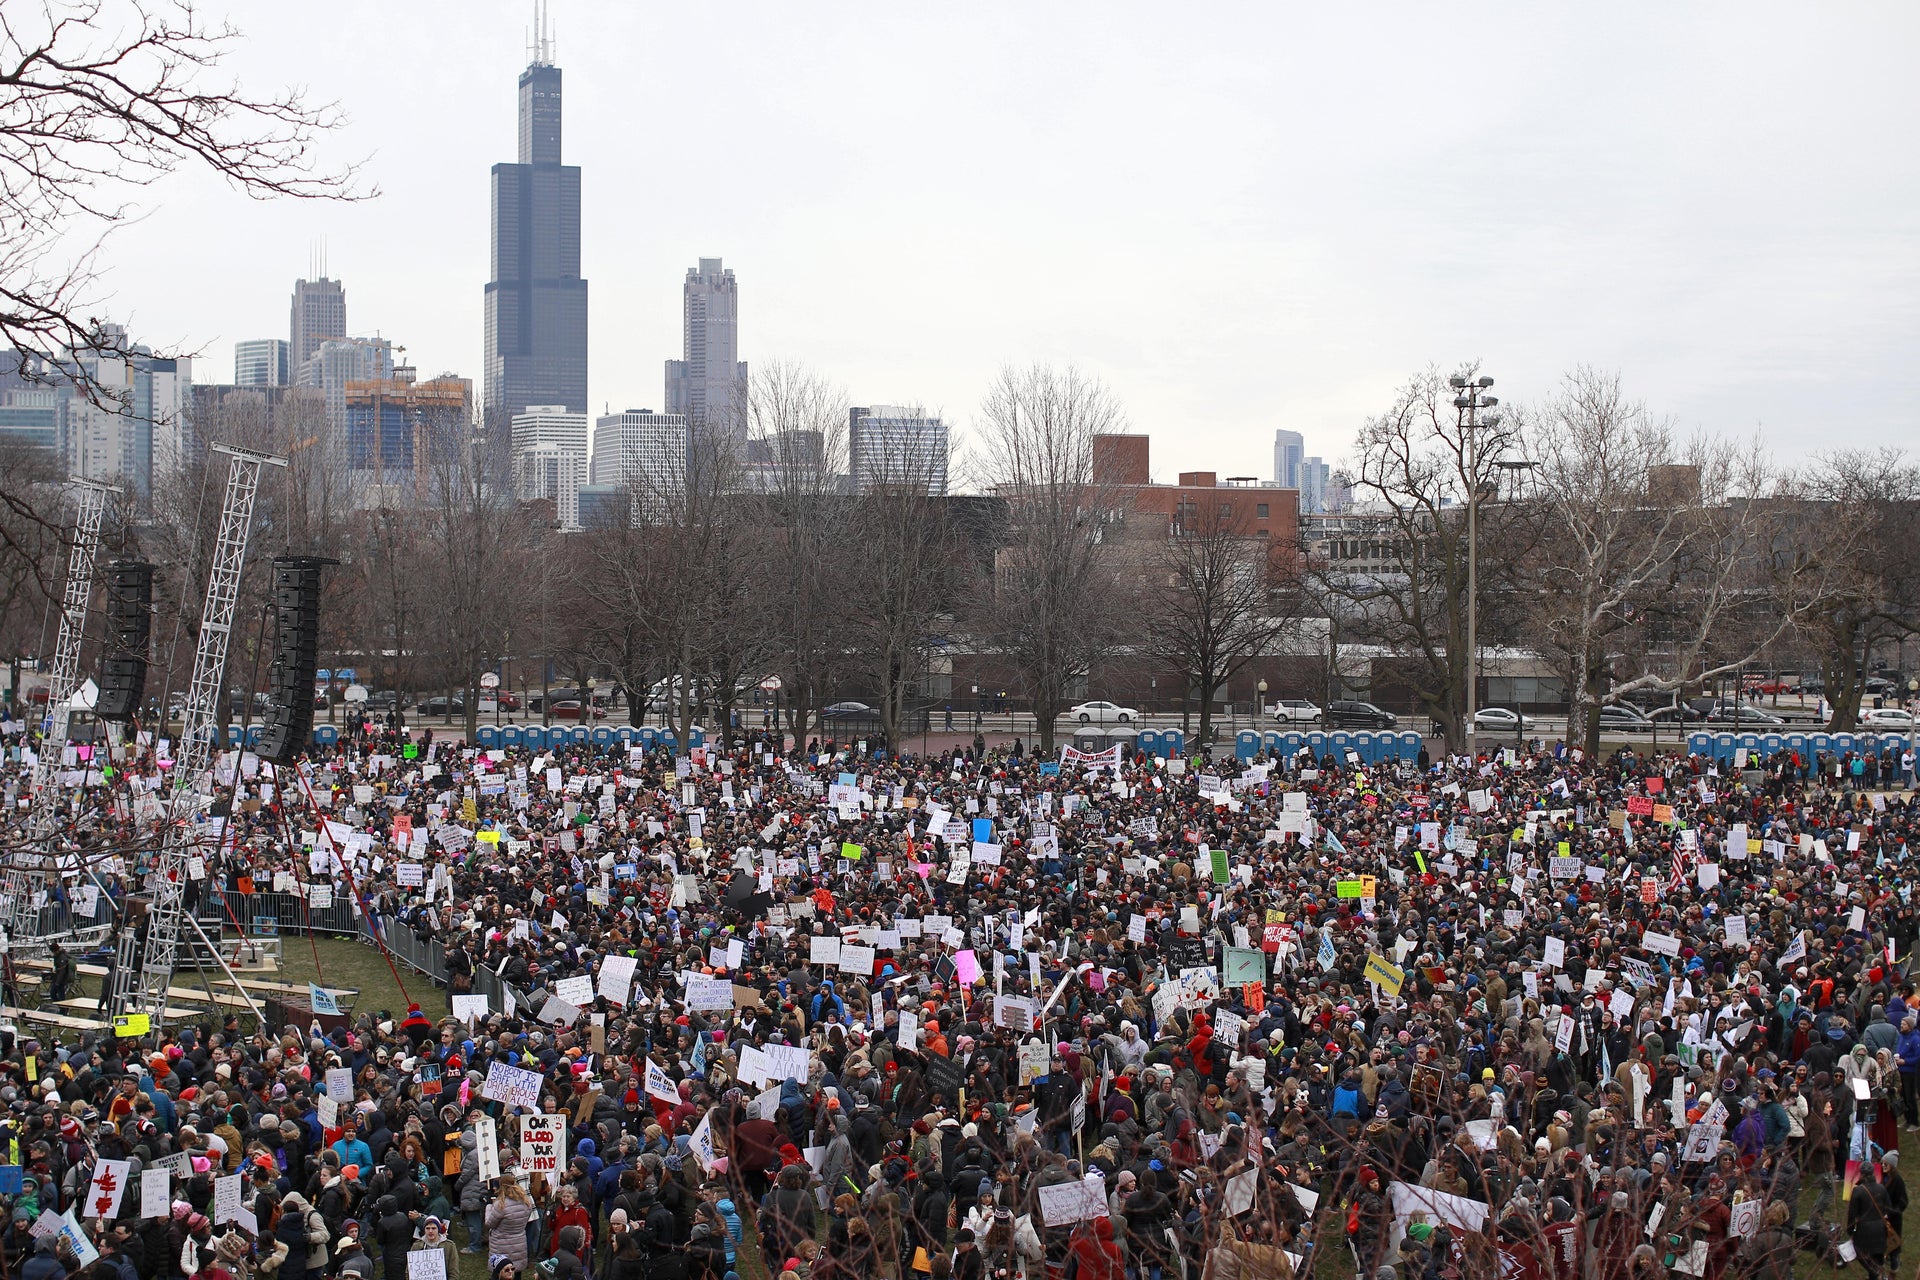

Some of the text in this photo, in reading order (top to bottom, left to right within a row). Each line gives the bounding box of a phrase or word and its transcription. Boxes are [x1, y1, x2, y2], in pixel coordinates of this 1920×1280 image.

[230, 447, 267, 459] CLEARWING
[1264, 926, 1291, 936] NOT ONE
[1368, 961, 1400, 986] #ENOUGH
[767, 1045, 794, 1062] NEVER
[492, 1062, 537, 1084] NOBODY IS
[649, 1074, 662, 1082] FOR
[773, 1060, 806, 1083] AGAIN
[492, 1072, 536, 1091] SAFE WITH
[529, 1116, 549, 1129] OUR
[523, 1130, 554, 1143] BLOOD
[531, 1144, 553, 1155] YOUR
[158, 1154, 184, 1166] PROTECT
[534, 1156, 557, 1170] HAND
[62, 1225, 84, 1255] MARCH
[415, 1261, 440, 1270] SCHOOL
